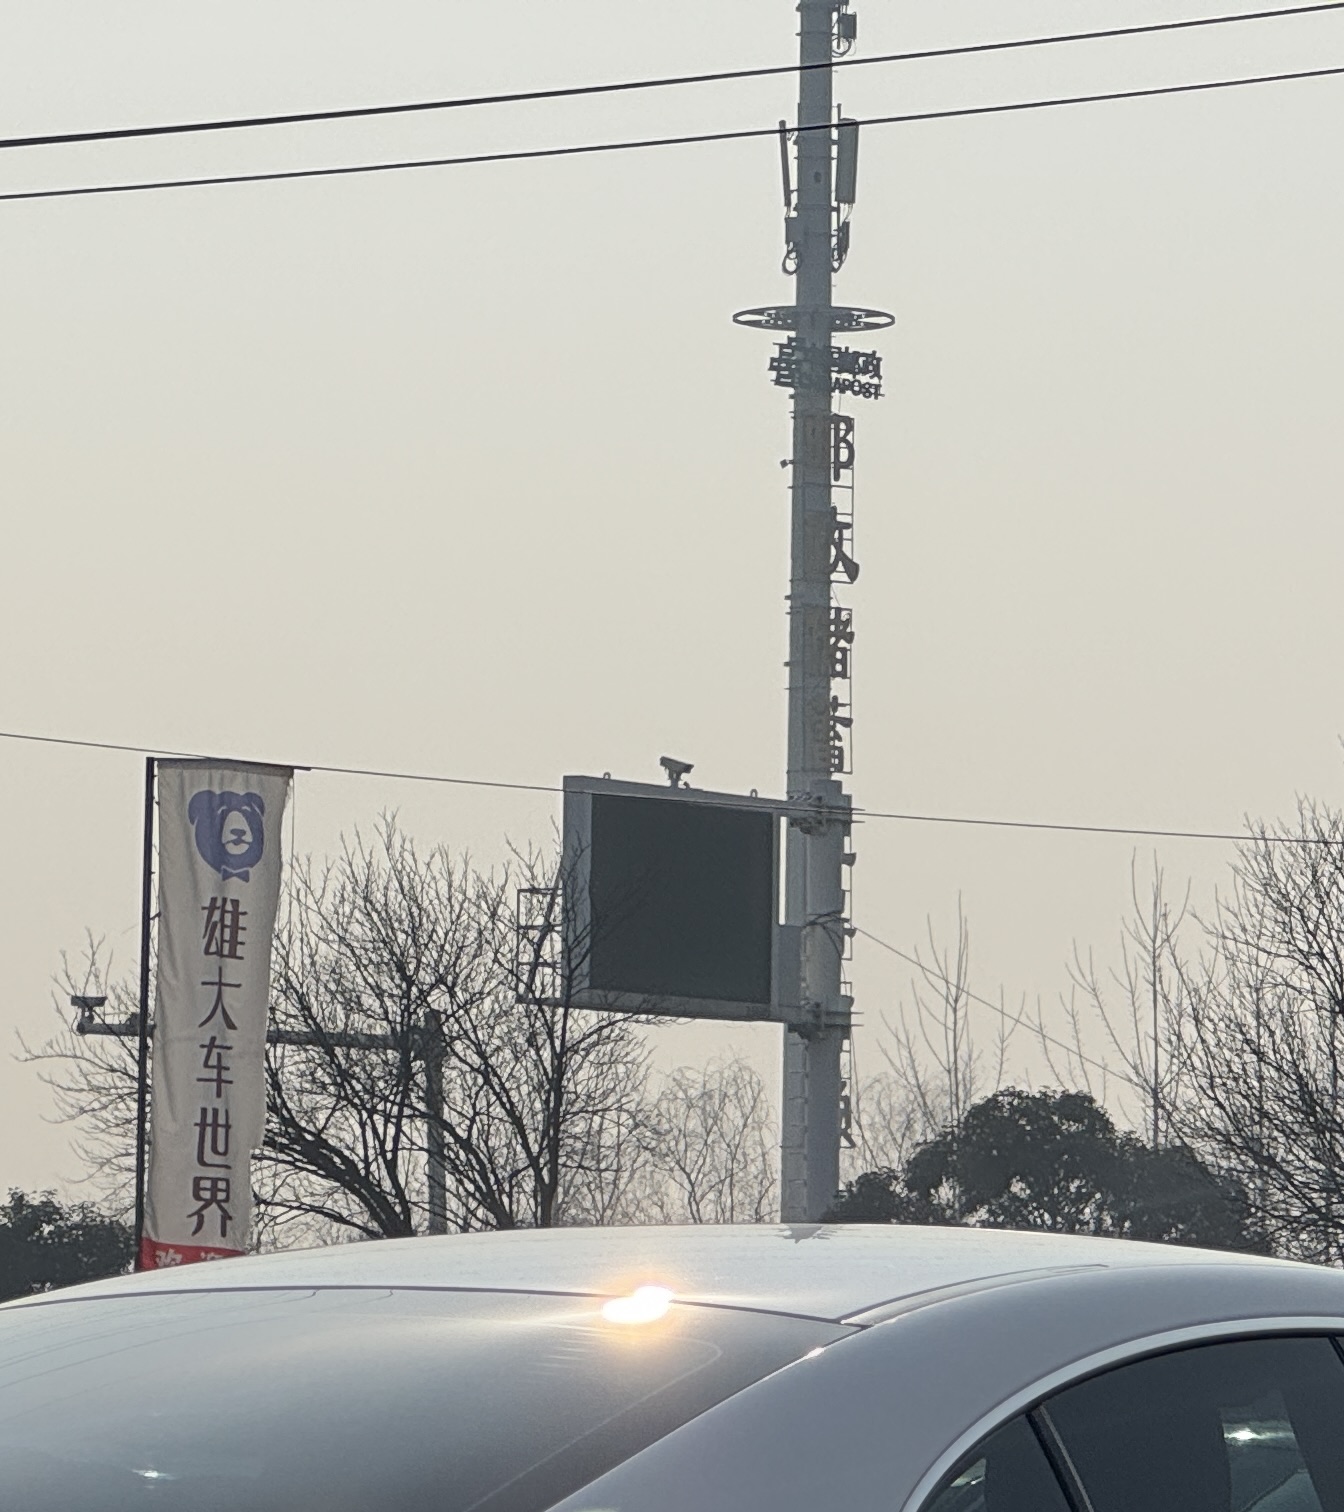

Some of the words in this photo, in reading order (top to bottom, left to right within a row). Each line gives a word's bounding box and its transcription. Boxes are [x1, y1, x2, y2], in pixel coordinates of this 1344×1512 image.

[186, 896, 248, 1238] 雄大车世界
